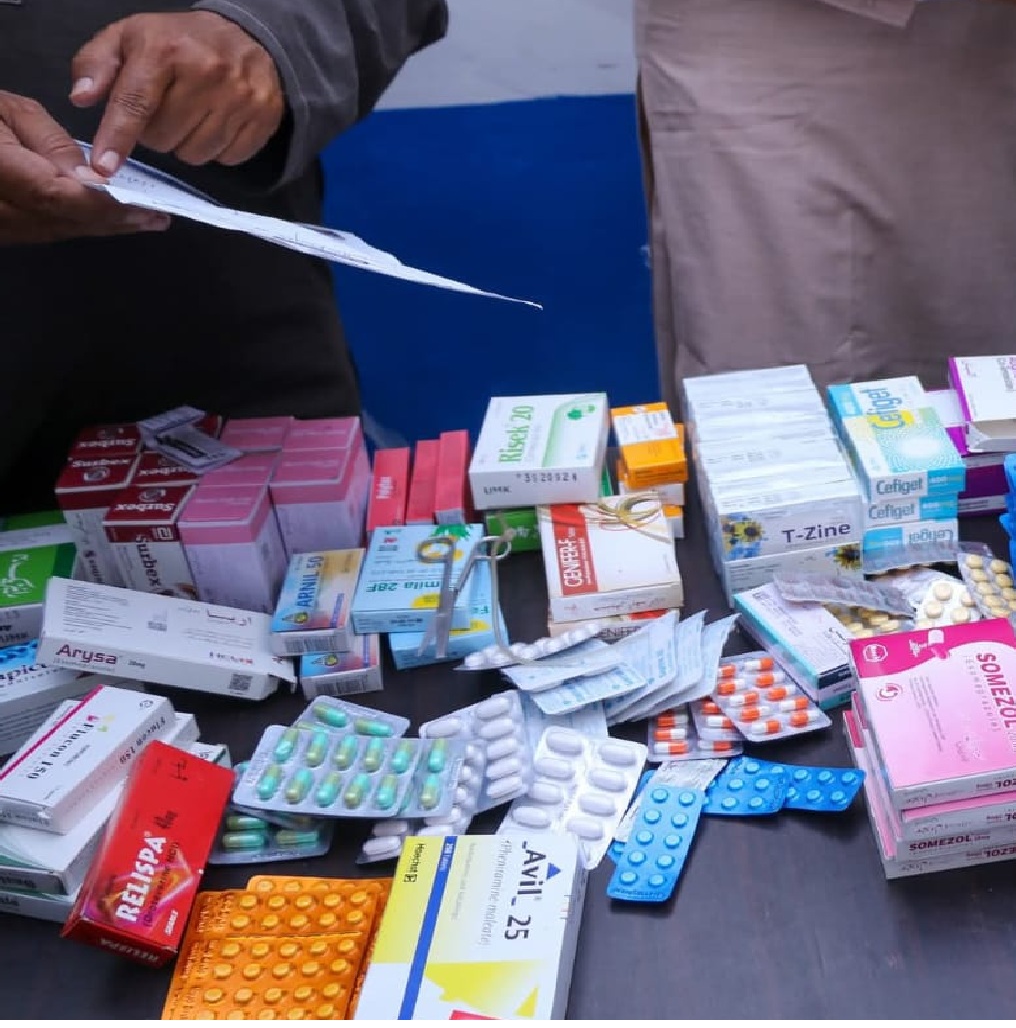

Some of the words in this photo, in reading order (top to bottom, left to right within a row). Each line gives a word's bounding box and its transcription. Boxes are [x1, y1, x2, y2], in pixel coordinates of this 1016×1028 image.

[499, 426, 531, 464] Risek
[138, 464, 189, 477] urbex
[876, 476, 924, 496] Cefiget
[868, 503, 916, 521] Cefiget
[782, 522, 851, 544] T-Zine
[296, 572, 321, 608] ARNIL
[404, 579, 442, 593] mila
[55, 643, 119, 666] Arysa
[908, 834, 972, 851] SOMEZOL
[115, 834, 168, 922] RELISPA
[516, 848, 549, 896] Avil
[504, 914, 532, 941] 25
